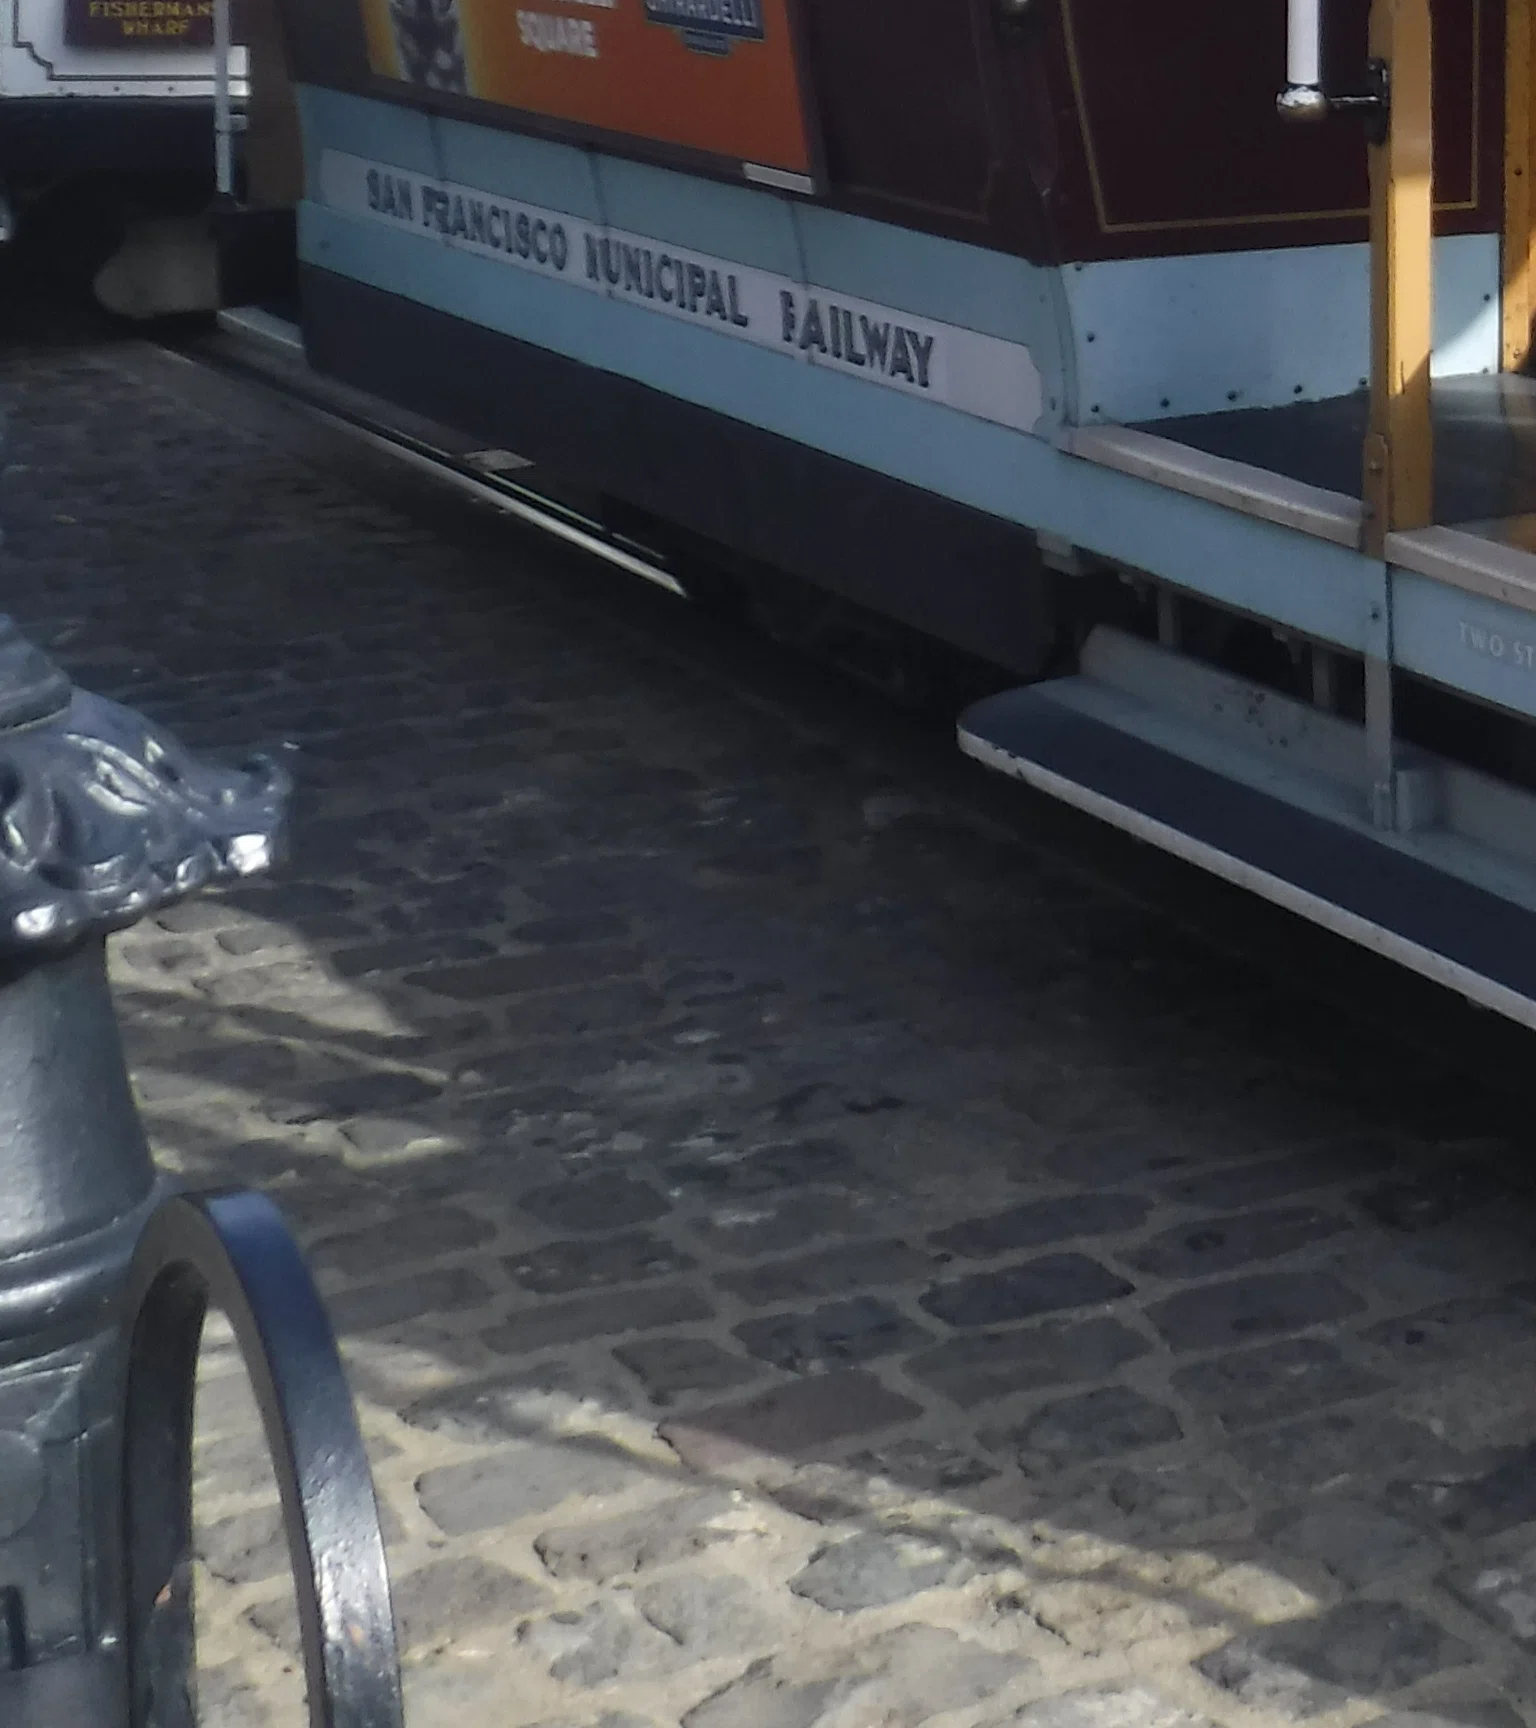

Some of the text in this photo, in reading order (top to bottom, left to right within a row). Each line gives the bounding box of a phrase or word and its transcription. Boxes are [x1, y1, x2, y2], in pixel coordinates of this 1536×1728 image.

[516, 10, 599, 58] SQUARE
[366, 168, 414, 221] SAN
[421, 185, 569, 272] FRANCISCO
[1457, 620, 1505, 658] TWO
